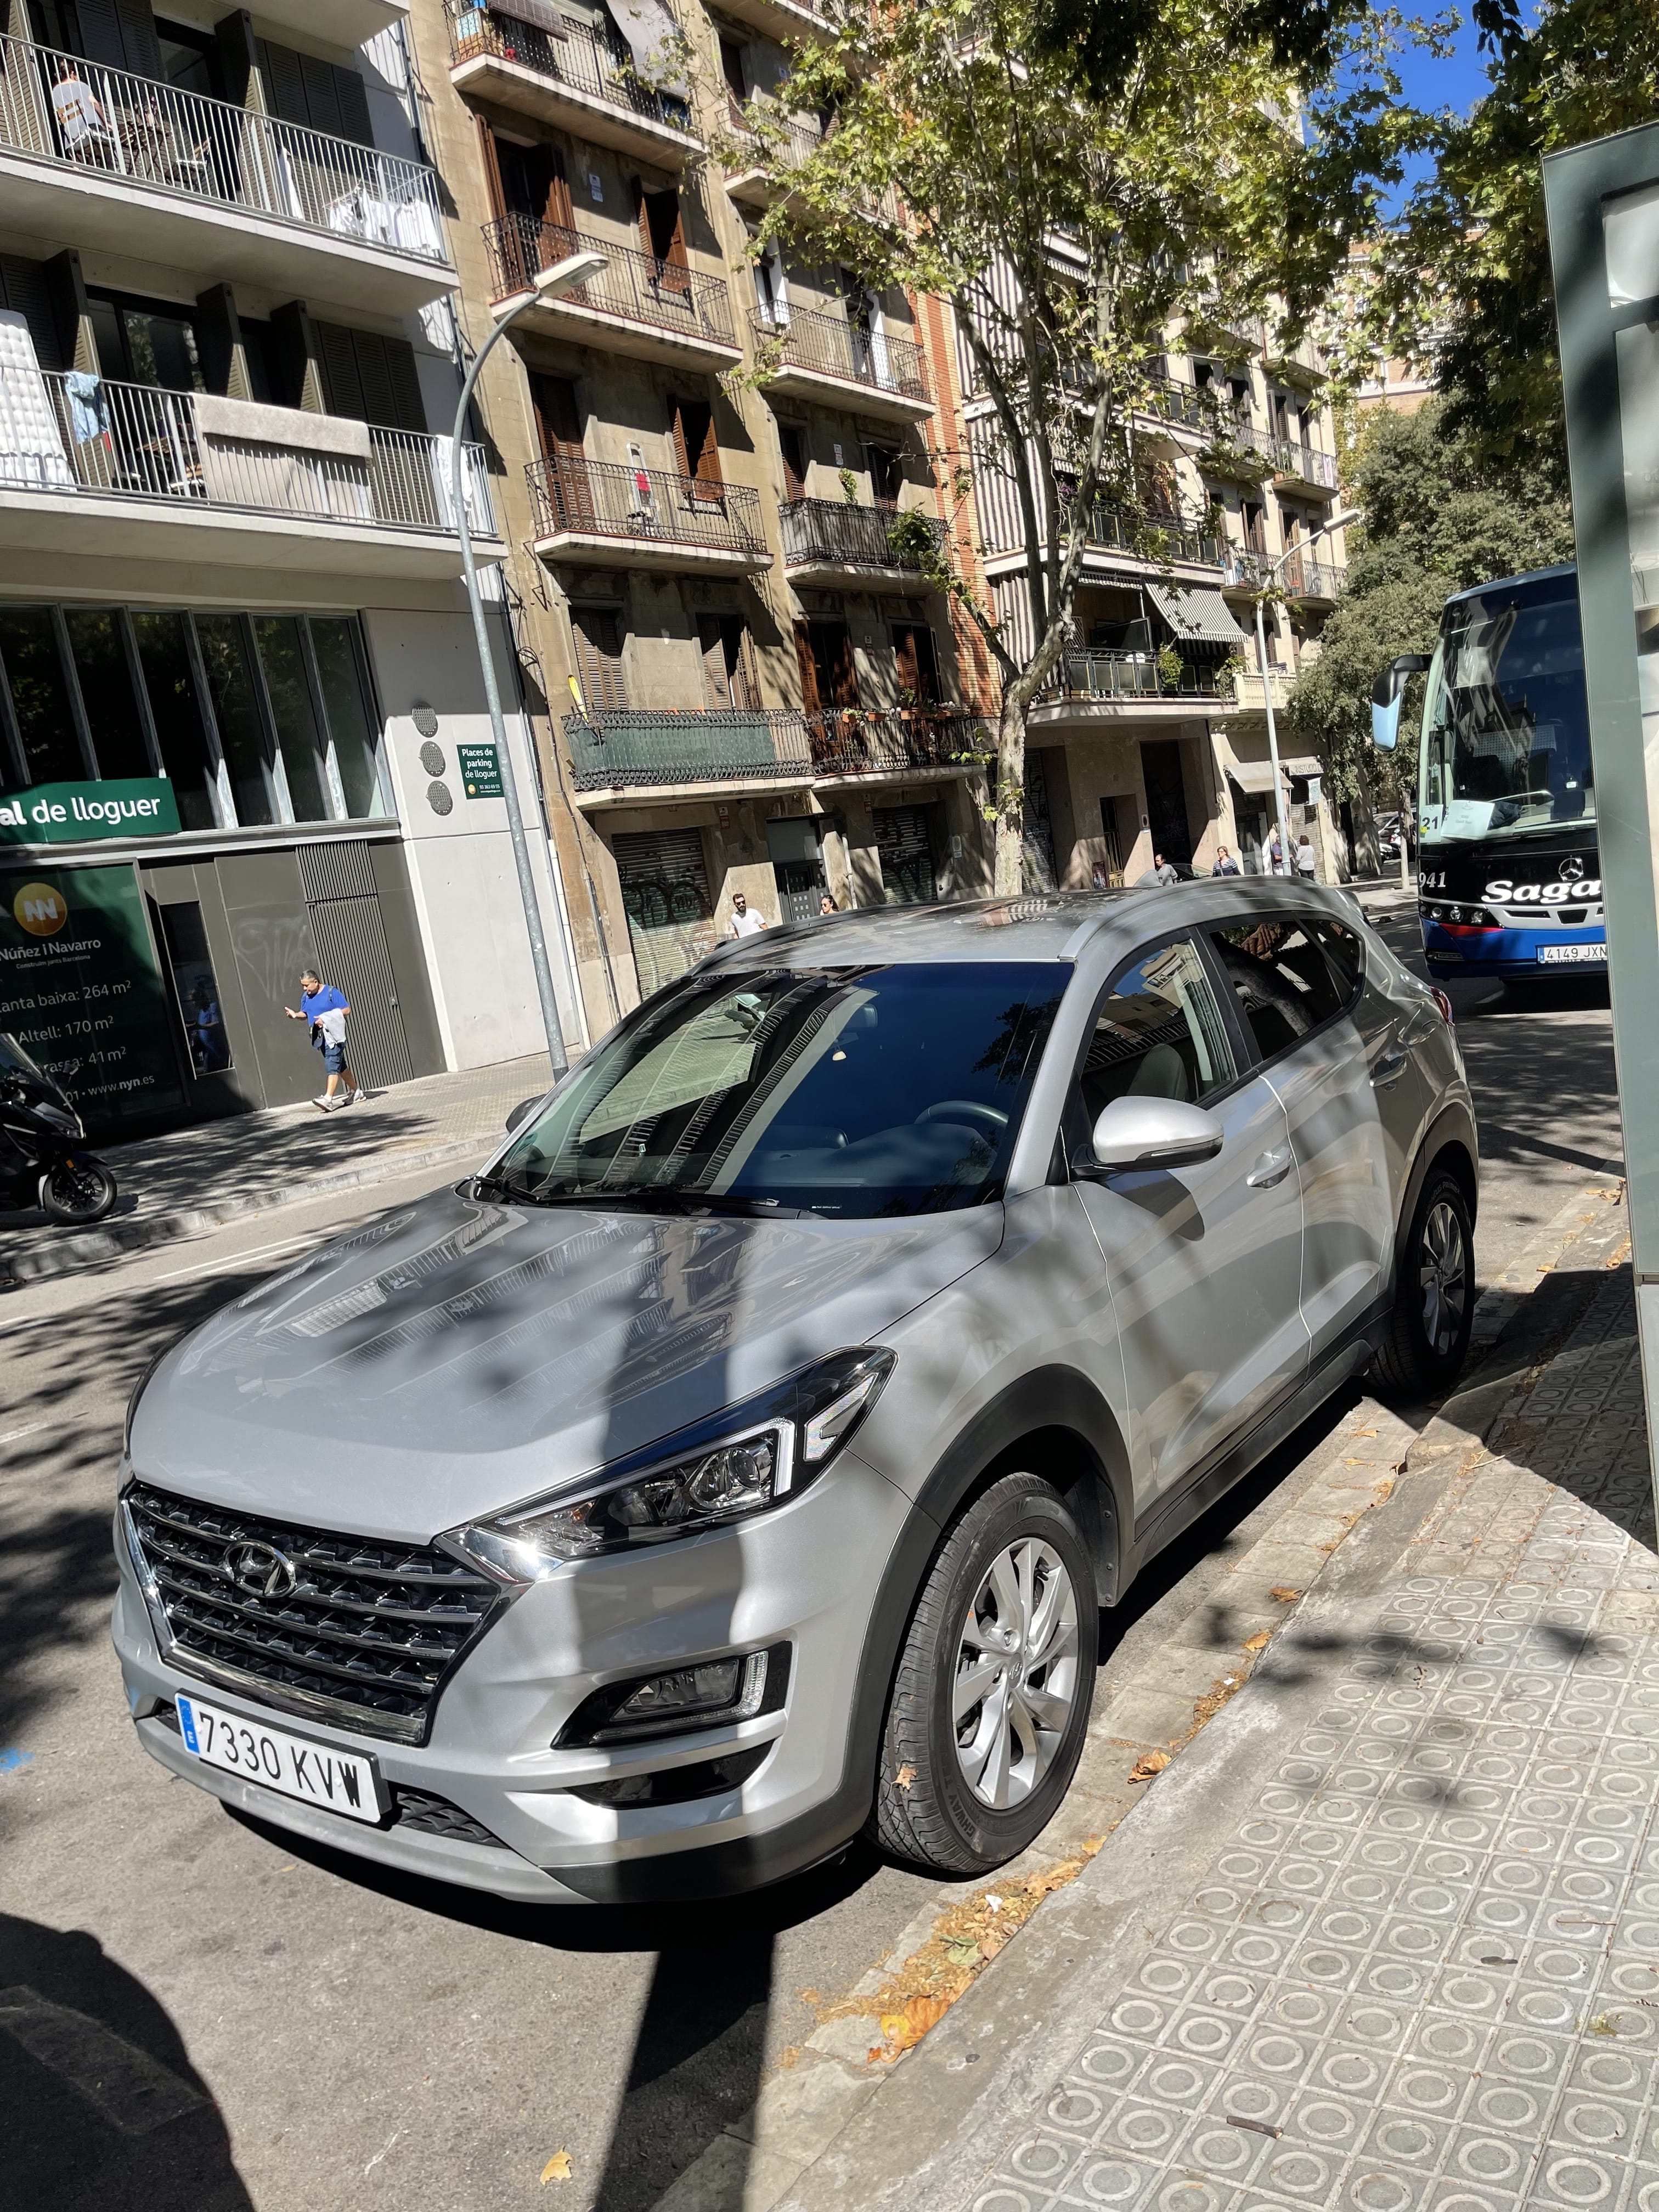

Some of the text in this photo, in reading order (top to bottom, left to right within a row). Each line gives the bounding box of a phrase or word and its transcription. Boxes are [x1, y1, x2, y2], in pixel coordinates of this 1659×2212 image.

[461, 748, 493, 757] Places de
[467, 759, 492, 769] parking
[474, 770, 497, 779] lloguer
[32, 799, 67, 823] de
[70, 797, 160, 825] lloguer
[1422, 816, 1438, 830] 21
[1419, 872, 1446, 888] 941
[48, 939, 101, 955] Navarro
[1547, 946, 1607, 958] 4149 JXN
[0, 997, 35, 1013] anta
[38, 991, 80, 1006] baixa:
[83, 984, 109, 999] 264
[19, 1026, 61, 1044] Altell:
[65, 1020, 91, 1035] 170
[43, 1057, 84, 1074] rassa:
[89, 1051, 104, 1064] 41
[88, 1075, 155, 1096] www.nyn.es
[199, 1711, 280, 1779] 7330
[290, 1745, 361, 1808] KVW
